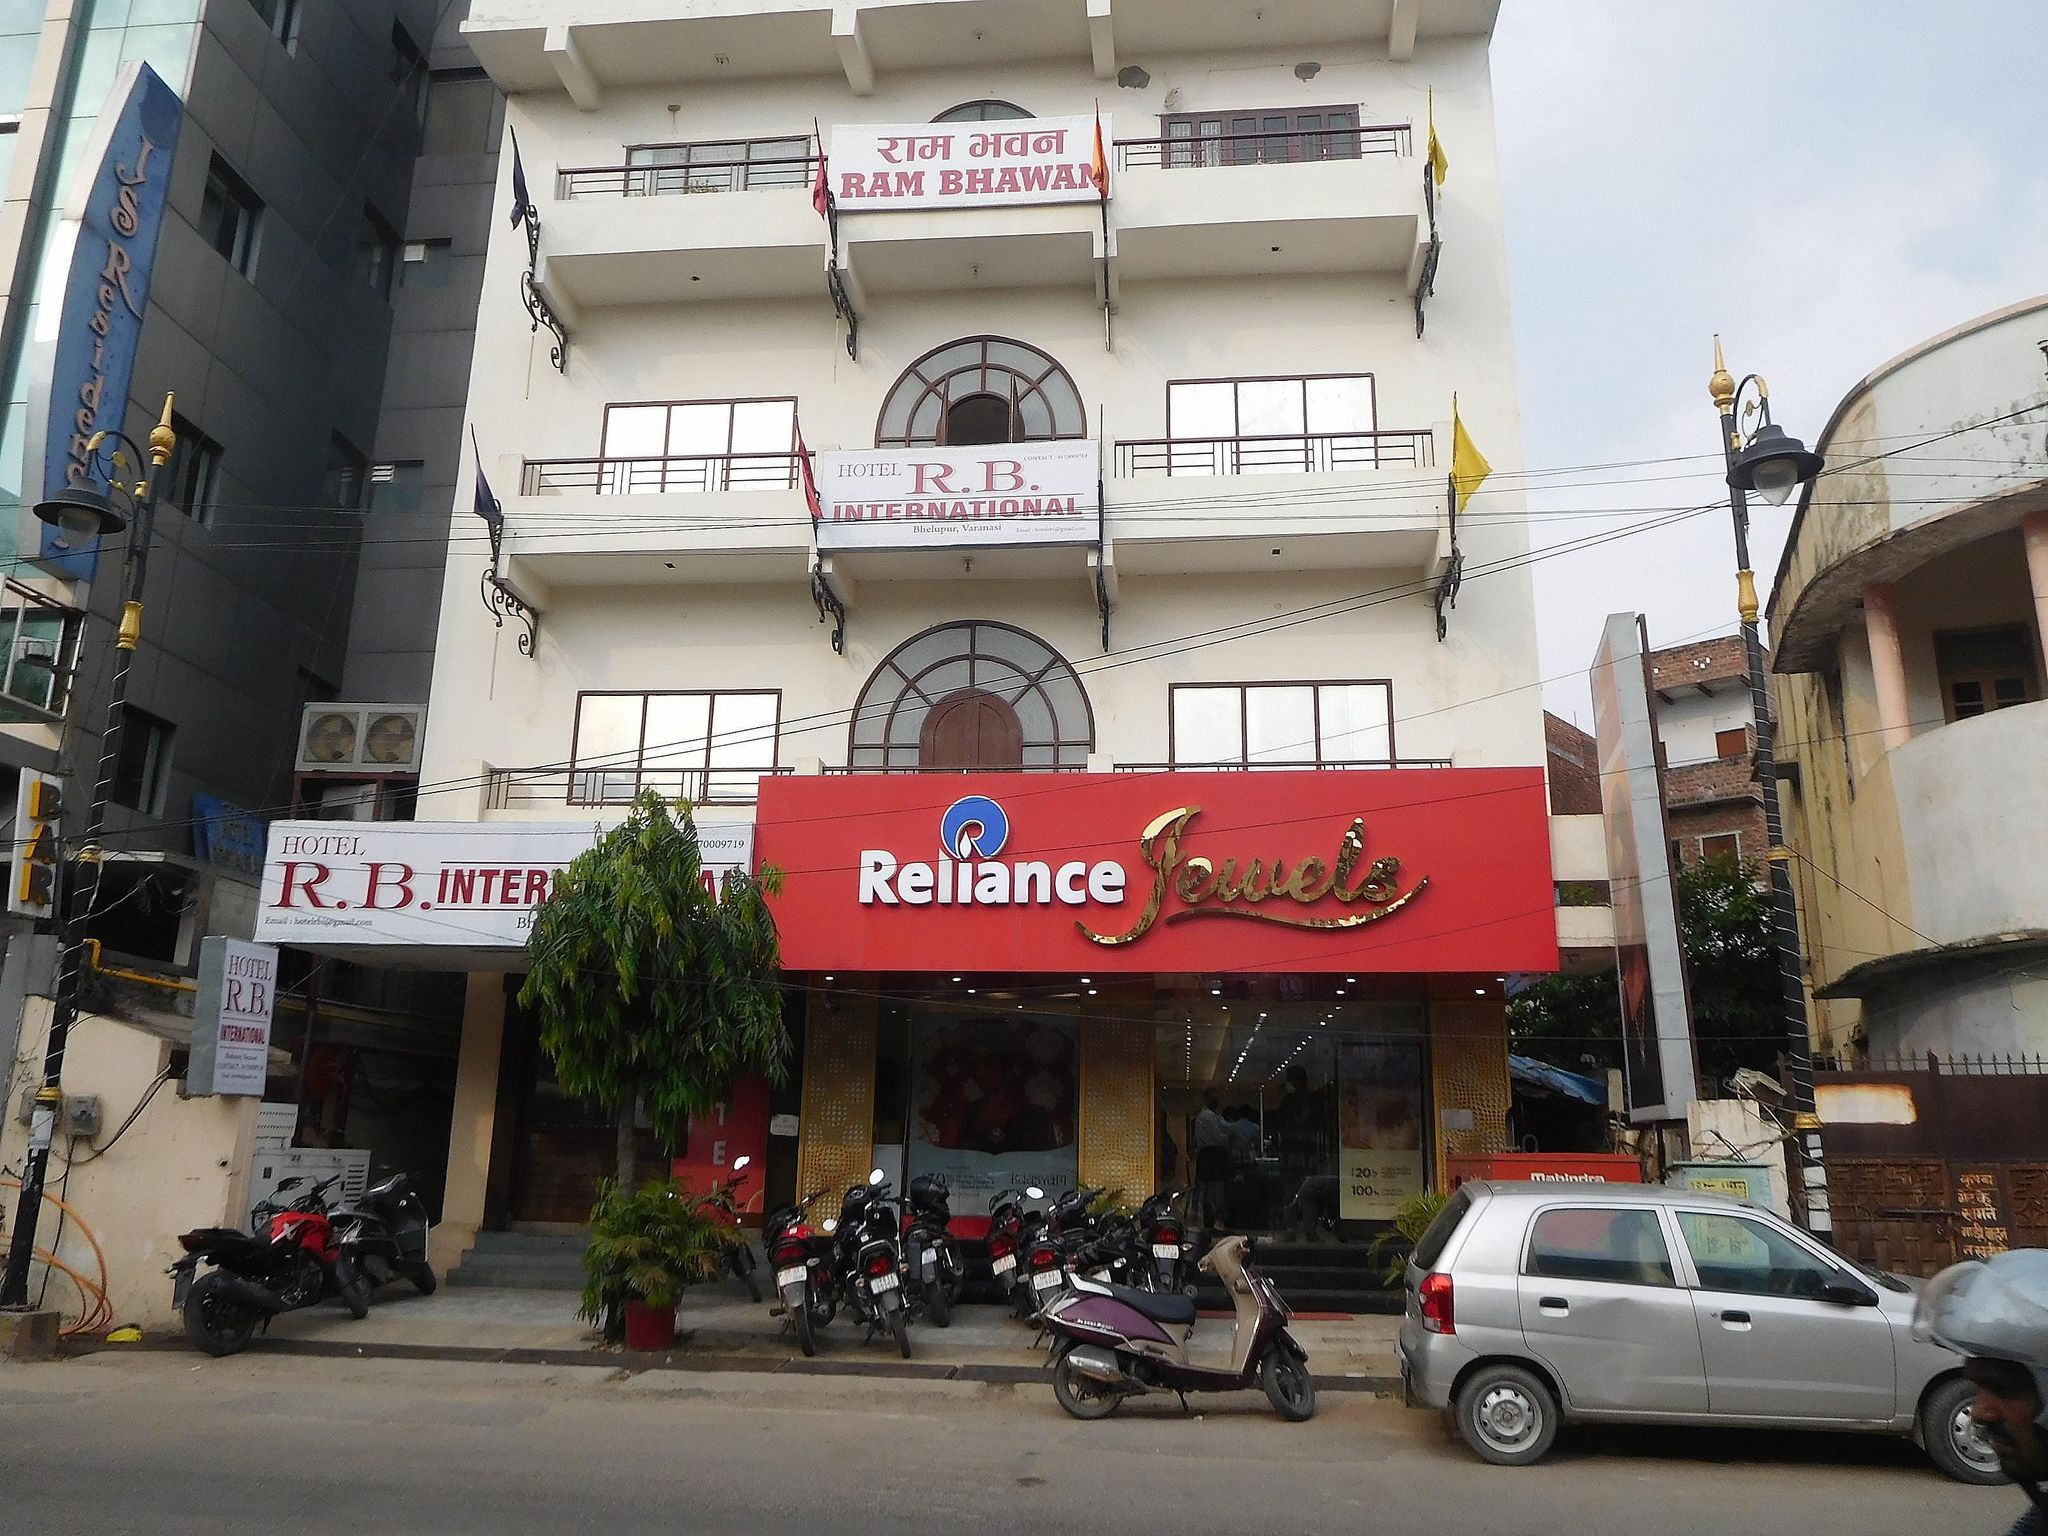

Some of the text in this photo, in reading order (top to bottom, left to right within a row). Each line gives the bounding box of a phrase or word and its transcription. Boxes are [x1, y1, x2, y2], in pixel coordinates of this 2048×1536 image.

[877, 129, 1068, 164] राम भवन
[840, 162, 1103, 198] RAM BHAWAN
[837, 459, 1041, 496] HOTEL R.B.
[833, 497, 1083, 522] INTERNATIONAL
[913, 523, 1002, 535] Bhelupur, Varanasi
[281, 835, 367, 856] HOTEL
[267, 861, 431, 911] R.B.
[858, 805, 1429, 946] Reliance Jewels
[227, 954, 273, 981] HOTEL
[223, 977, 269, 1016] R.B.
